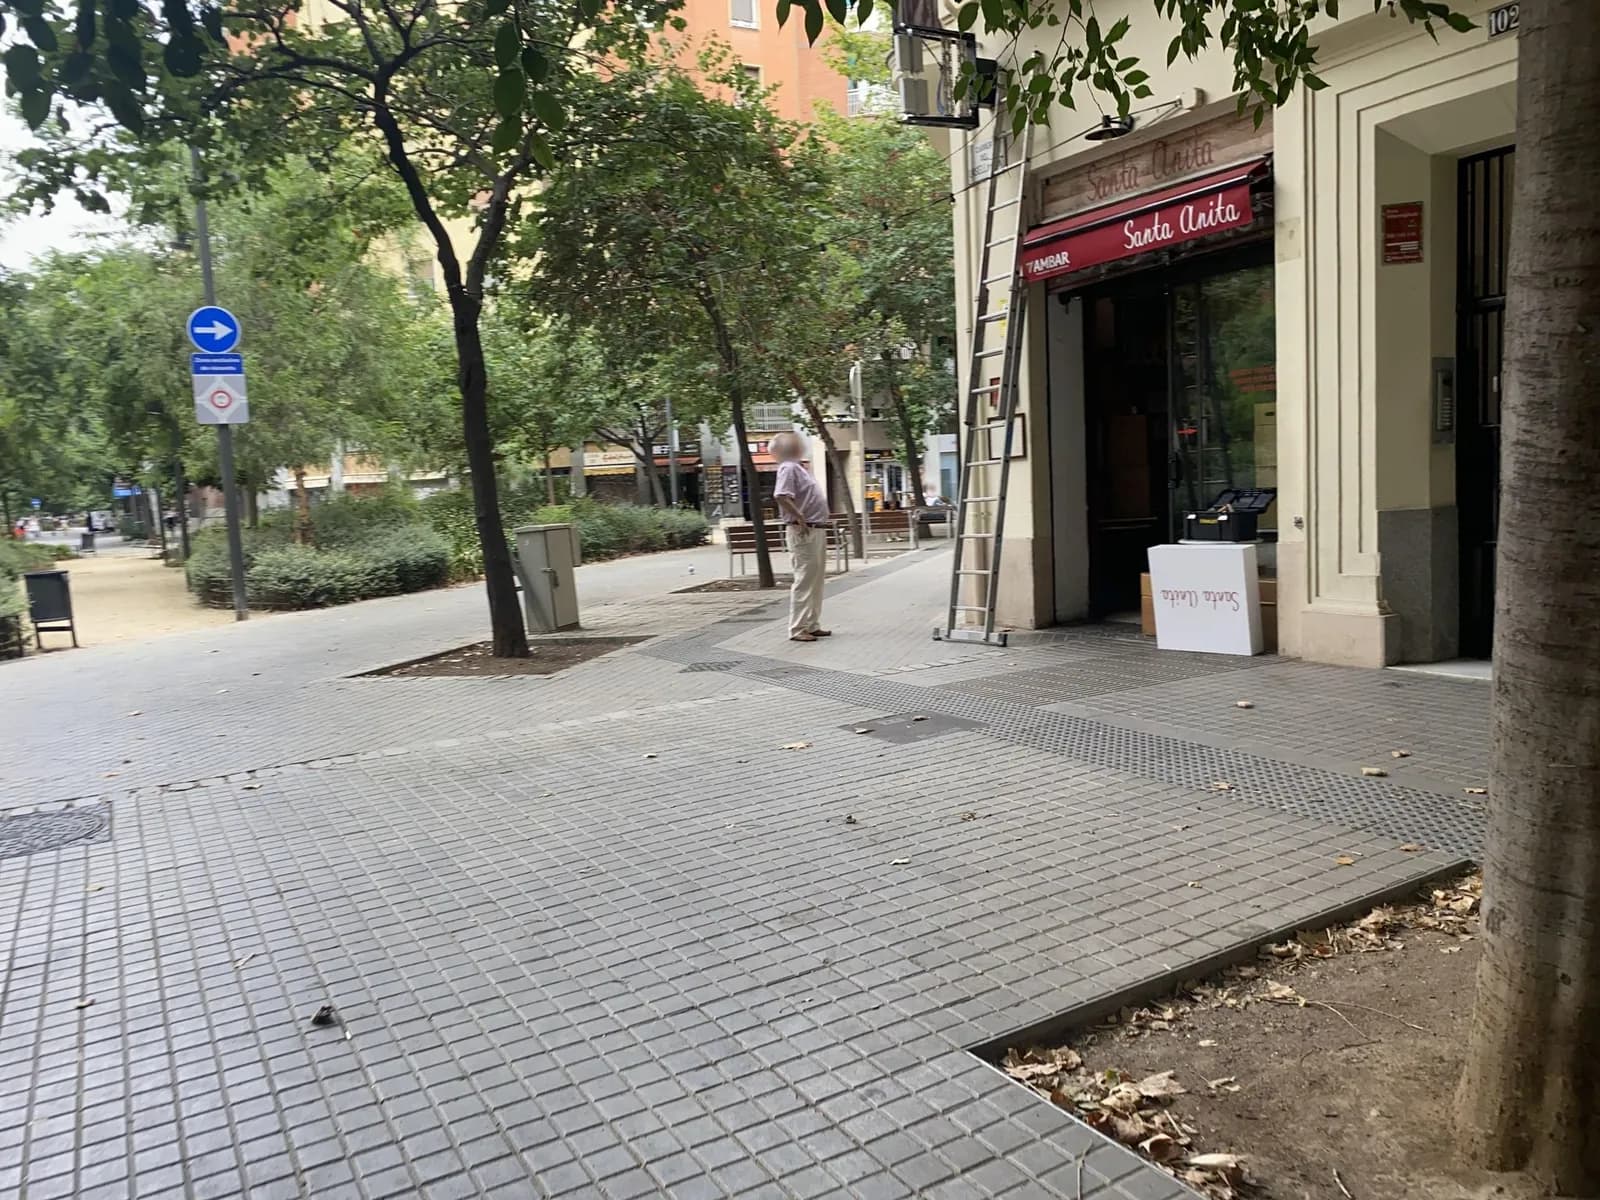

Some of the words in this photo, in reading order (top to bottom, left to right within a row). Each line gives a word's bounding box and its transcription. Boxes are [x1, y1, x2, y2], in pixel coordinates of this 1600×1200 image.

[1489, 5, 1520, 35] 102
[1087, 151, 1140, 201] Santa
[1152, 128, 1214, 180] Anita
[1123, 211, 1175, 249] Santa
[1180, 192, 1241, 234] Anita
[1160, 589, 1199, 608] Anita
[1201, 590, 1240, 612] Santa
